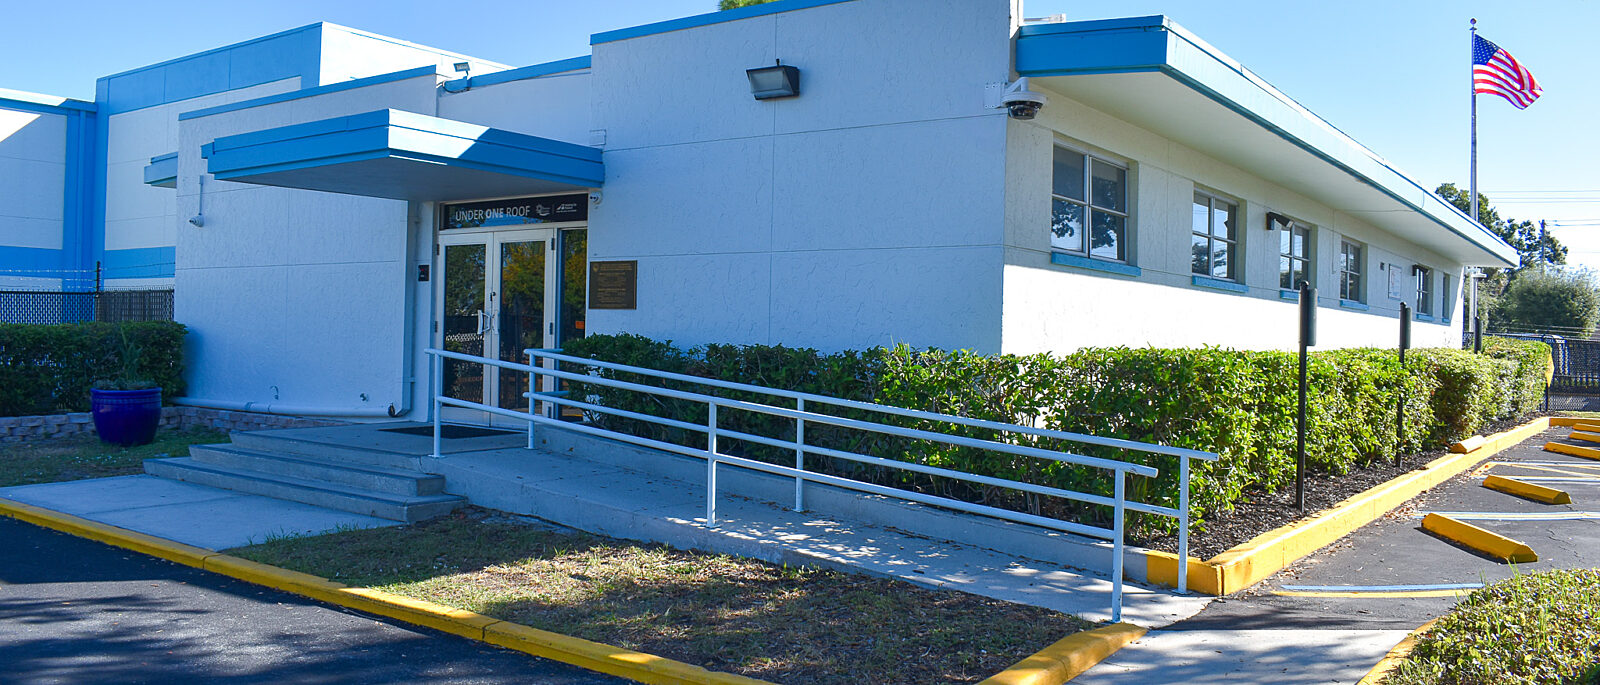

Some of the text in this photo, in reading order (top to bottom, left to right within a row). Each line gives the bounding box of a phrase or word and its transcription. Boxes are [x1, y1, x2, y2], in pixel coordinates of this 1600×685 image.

[455, 209, 484, 221] UNDER
[485, 208, 504, 219] ONE
[506, 205, 531, 217] ROOF
